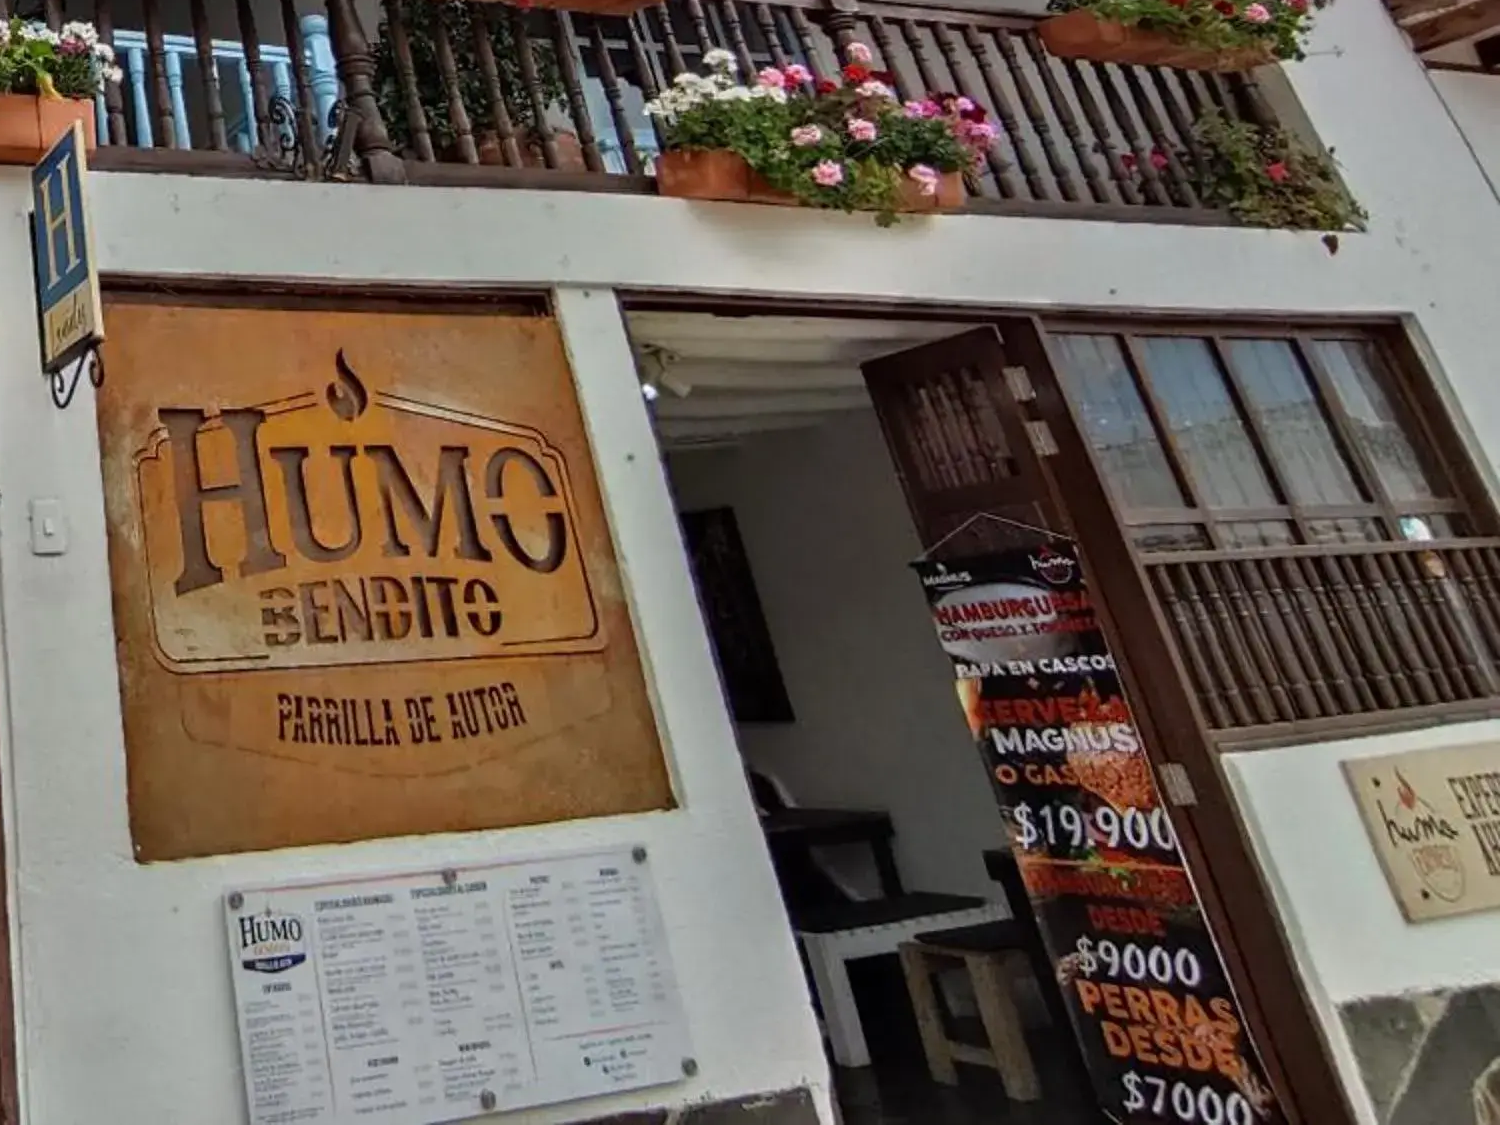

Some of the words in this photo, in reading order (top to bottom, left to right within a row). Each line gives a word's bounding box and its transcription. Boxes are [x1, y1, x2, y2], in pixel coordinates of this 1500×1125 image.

[39, 151, 81, 290] H
[157, 407, 567, 597] HUMO
[259, 575, 503, 647] BENDITO
[956, 662, 1007, 679] PAPA
[1008, 660, 1035, 676] EN
[276, 692, 400, 746] PARRILLA
[405, 695, 442, 744] DE
[444, 682, 528, 740] AUTOR
[989, 722, 1141, 755] MAGNUS
[1012, 801, 1175, 851] $19.900
[239, 915, 303, 949] HUMO
[1085, 903, 1168, 938] DESDE
[1076, 934, 1201, 988] $9000
[1075, 979, 1241, 1036] PERRAS
[1101, 1020, 1242, 1079] DESDE
[1121, 1070, 1253, 1125] $7000
